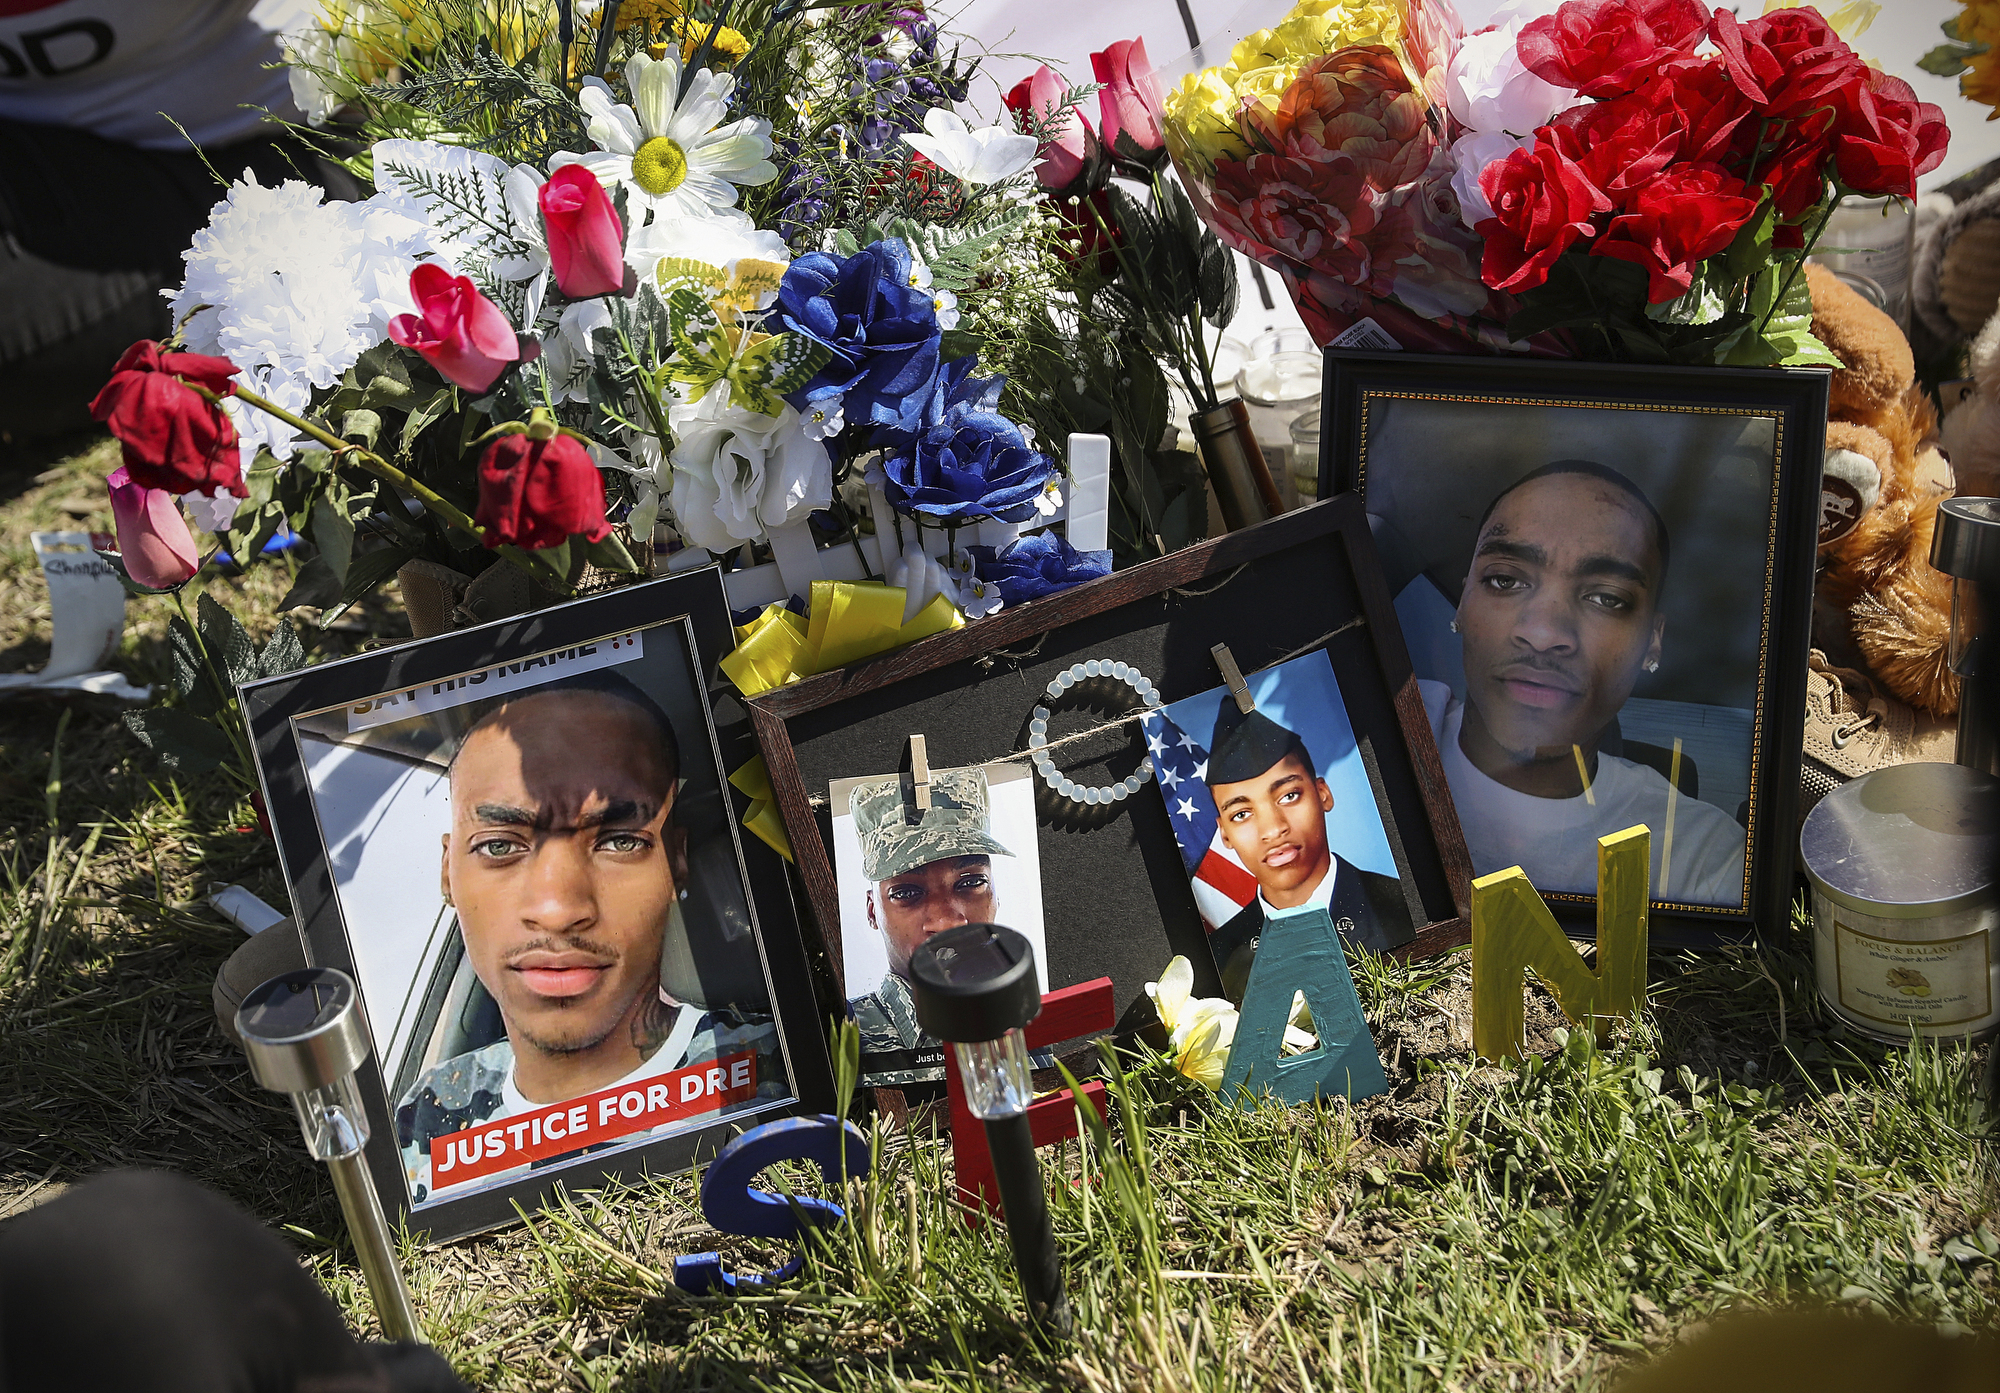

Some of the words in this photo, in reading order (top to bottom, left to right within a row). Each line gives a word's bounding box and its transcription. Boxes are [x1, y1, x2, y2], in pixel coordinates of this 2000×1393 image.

[1854, 937, 1891, 953] FOCUS
[1894, 947, 1903, 955] &
[1906, 943, 1963, 955] BALANCE
[1869, 950, 1889, 960] White
[915, 1053, 935, 1063] Just
[437, 1105, 589, 1172] JUSTICE
[598, 1084, 669, 1127] FOR
[680, 1059, 750, 1103] DRE
